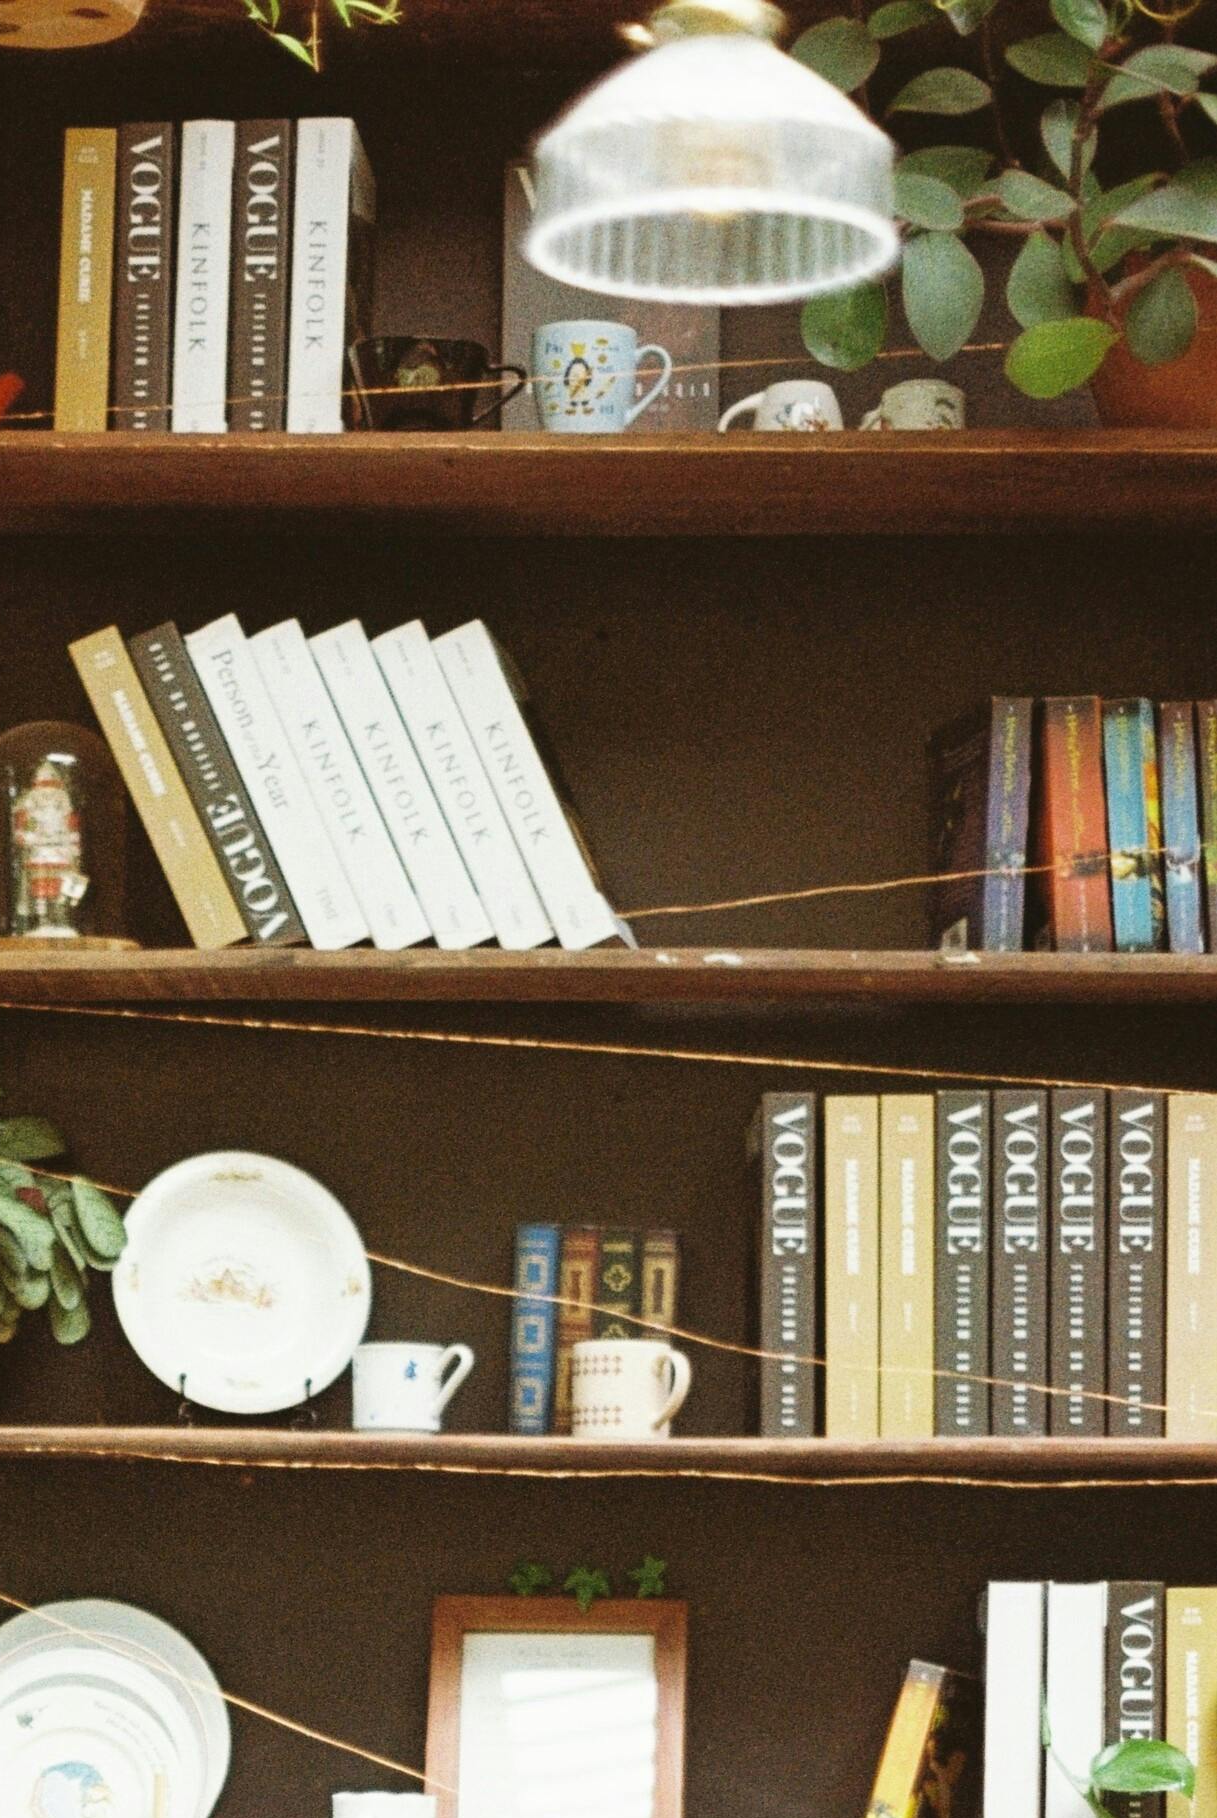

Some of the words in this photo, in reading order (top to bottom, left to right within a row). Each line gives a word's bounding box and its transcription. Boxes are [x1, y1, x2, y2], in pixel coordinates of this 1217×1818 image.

[127, 135, 163, 282] VOGUE
[244, 135, 280, 282] VOGUE
[188, 222, 211, 351] KINFOLK
[305, 220, 328, 349] KINFOLK
[211, 648, 254, 729] Person
[257, 752, 292, 810] Year
[301, 719, 366, 845] KINFOLK
[363, 721, 429, 846] KINFOLK
[425, 721, 492, 846] KINFOLK
[484, 721, 551, 846] KINFOLK
[207, 793, 289, 940] VOGUE
[772, 1105, 807, 1256] VOGUE
[947, 1104, 982, 1254] VOGUE
[1004, 1103, 1039, 1254] VOGUE
[1060, 1102, 1095, 1254] VOGUE
[1119, 1103, 1154, 1254] VOGUE
